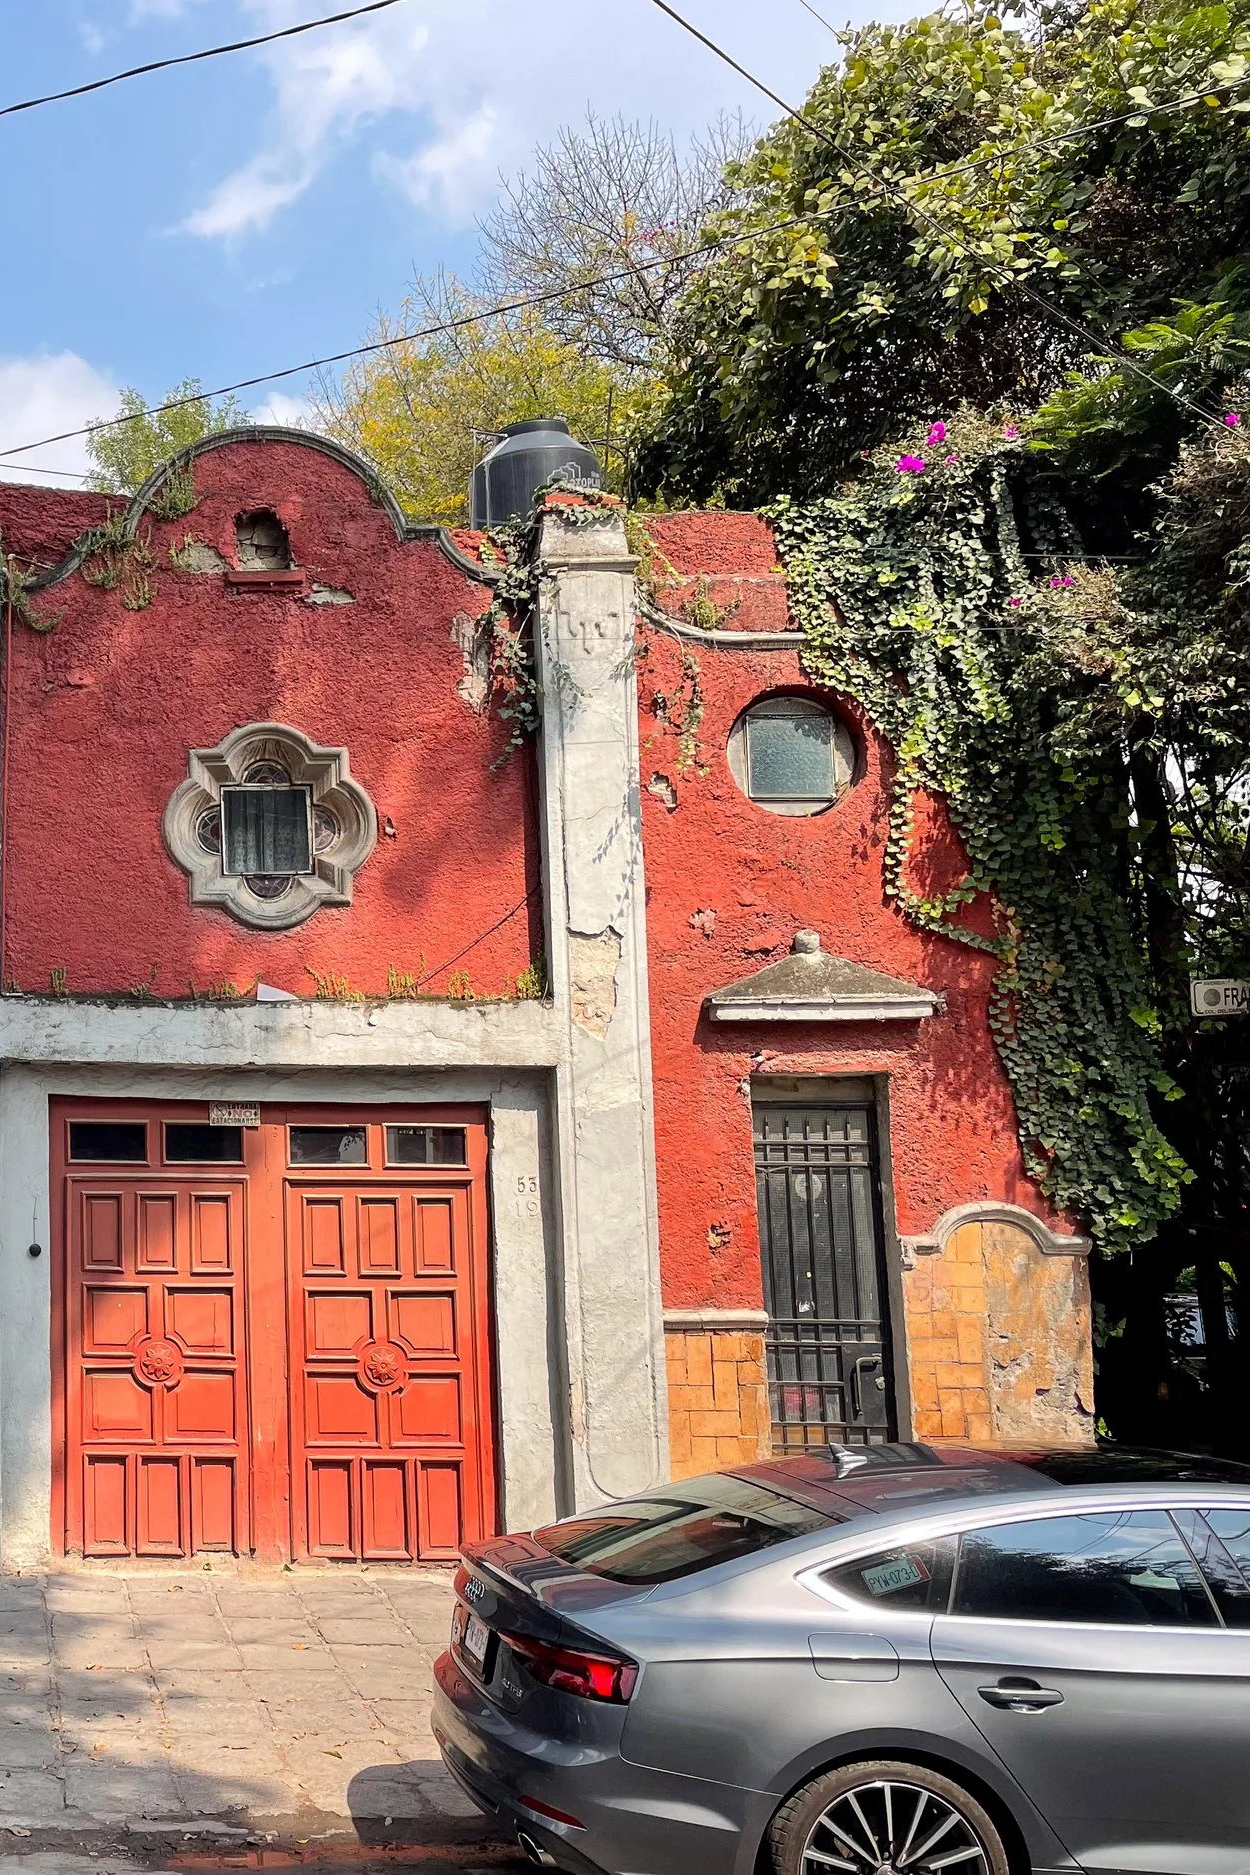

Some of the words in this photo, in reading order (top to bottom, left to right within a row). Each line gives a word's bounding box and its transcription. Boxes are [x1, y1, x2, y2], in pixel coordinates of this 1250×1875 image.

[1224, 987, 1250, 1007] FRA
[233, 1109, 253, 1118] NO
[212, 1117, 258, 1125] ESTACIONARSE
[517, 1175, 537, 1193] 53
